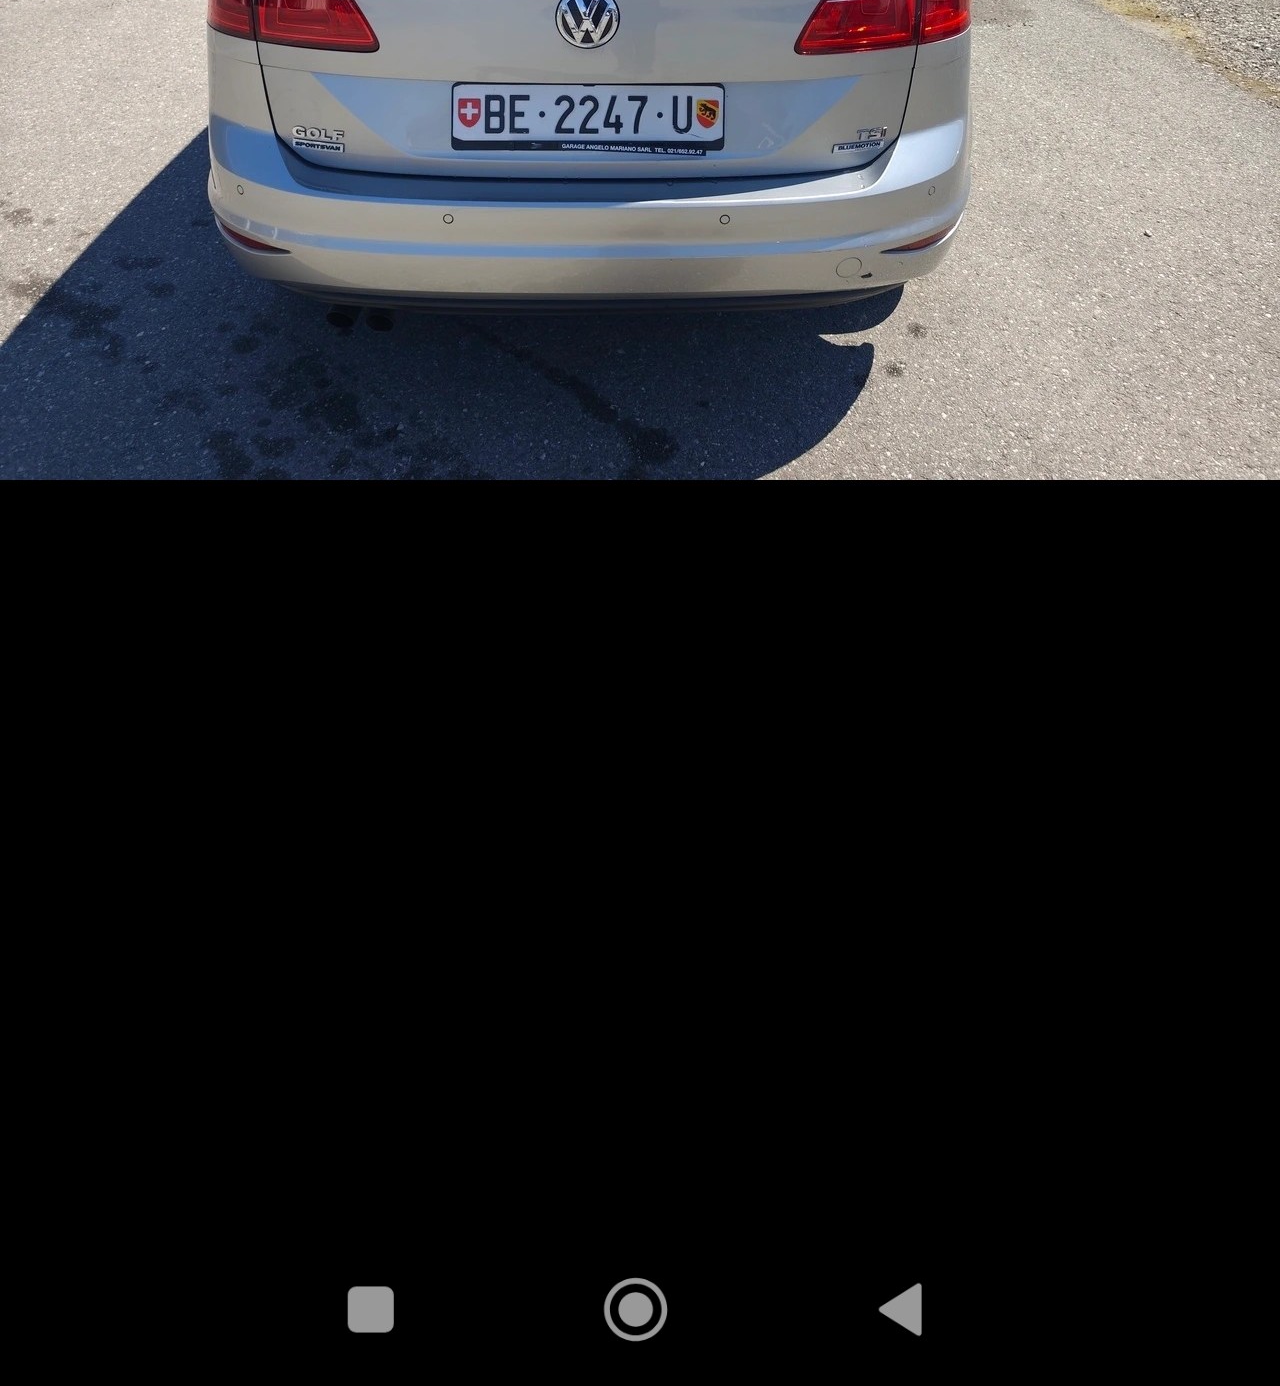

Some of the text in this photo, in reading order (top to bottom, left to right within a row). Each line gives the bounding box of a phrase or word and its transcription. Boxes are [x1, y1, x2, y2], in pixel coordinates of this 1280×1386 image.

[292, 125, 345, 141] GOLF
[857, 126, 888, 140] TSI
[295, 141, 341, 151] SPORTSVAN
[838, 141, 881, 151] BLUEMOTION
